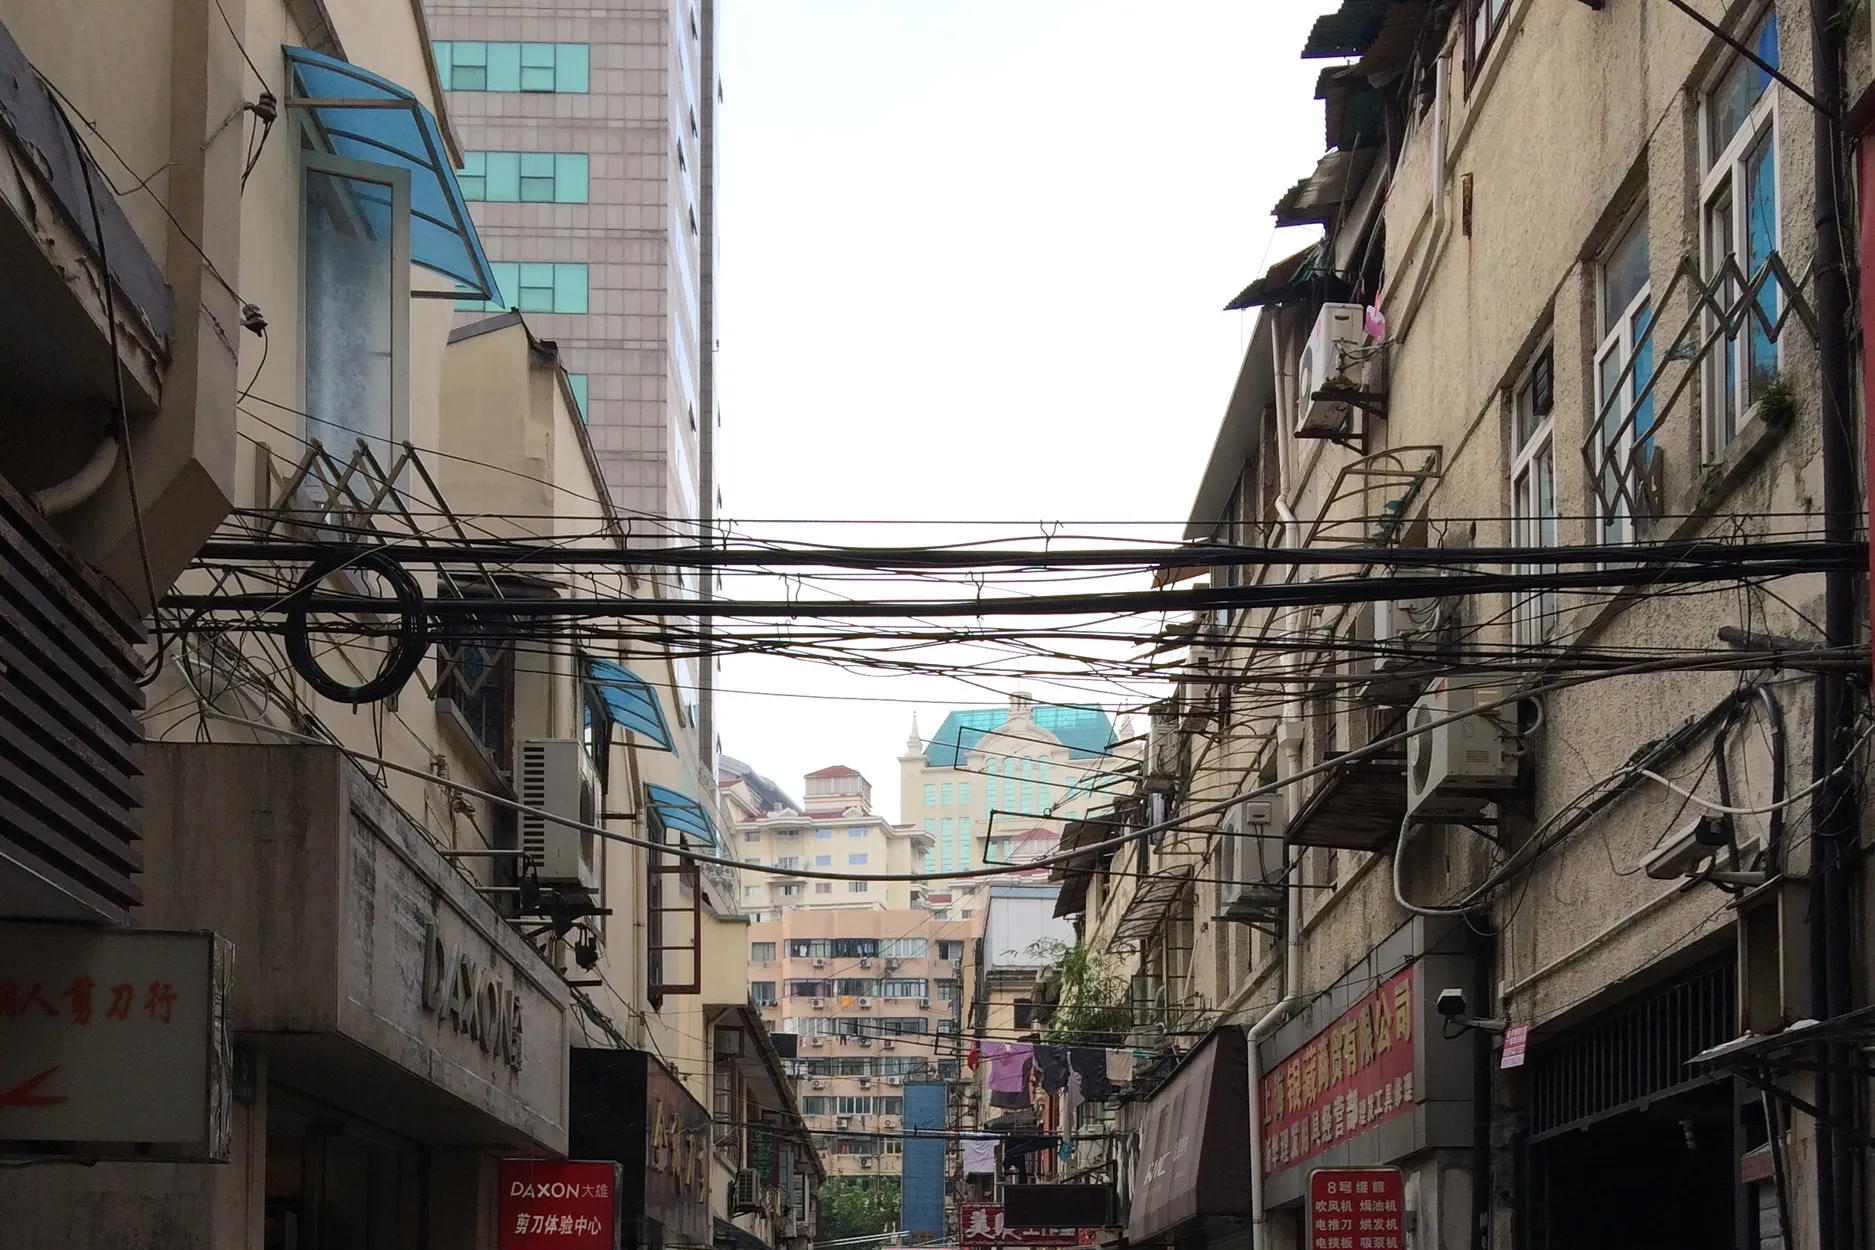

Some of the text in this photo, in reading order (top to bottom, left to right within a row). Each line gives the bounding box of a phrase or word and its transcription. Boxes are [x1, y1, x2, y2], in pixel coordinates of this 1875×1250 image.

[510, 1180, 580, 1199] DAXON
[1315, 1199, 1353, 1213] 吹风机
[513, 1212, 603, 1236] 剪刀体验中心
[1315, 1217, 1398, 1231] 电推刀 烘发机
